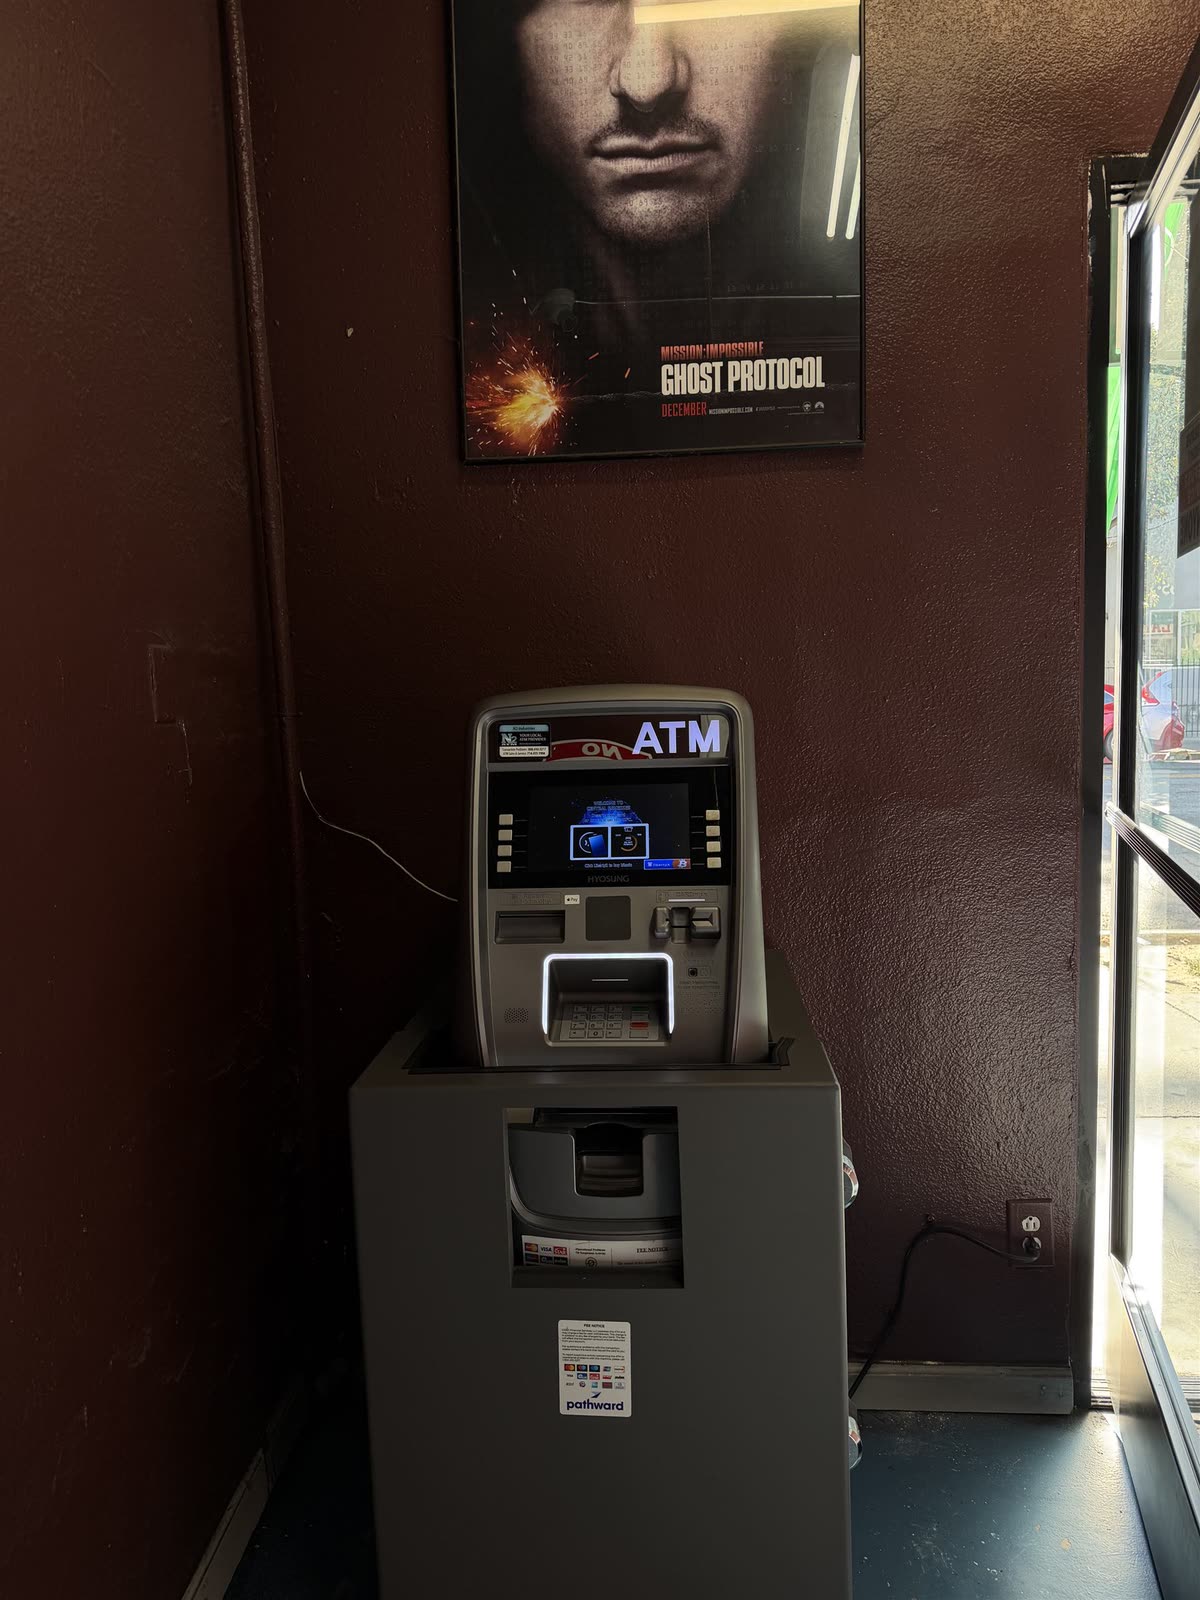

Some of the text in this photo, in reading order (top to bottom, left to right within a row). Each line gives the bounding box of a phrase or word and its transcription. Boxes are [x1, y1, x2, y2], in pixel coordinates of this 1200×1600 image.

[661, 341, 764, 361] MISSION:IMPOSSIBLE
[661, 356, 825, 396] GHOST PROTOCOL
[662, 402, 707, 417] DECEMBER
[632, 720, 720, 754] ATM
[567, 1399, 624, 1410] pathward
